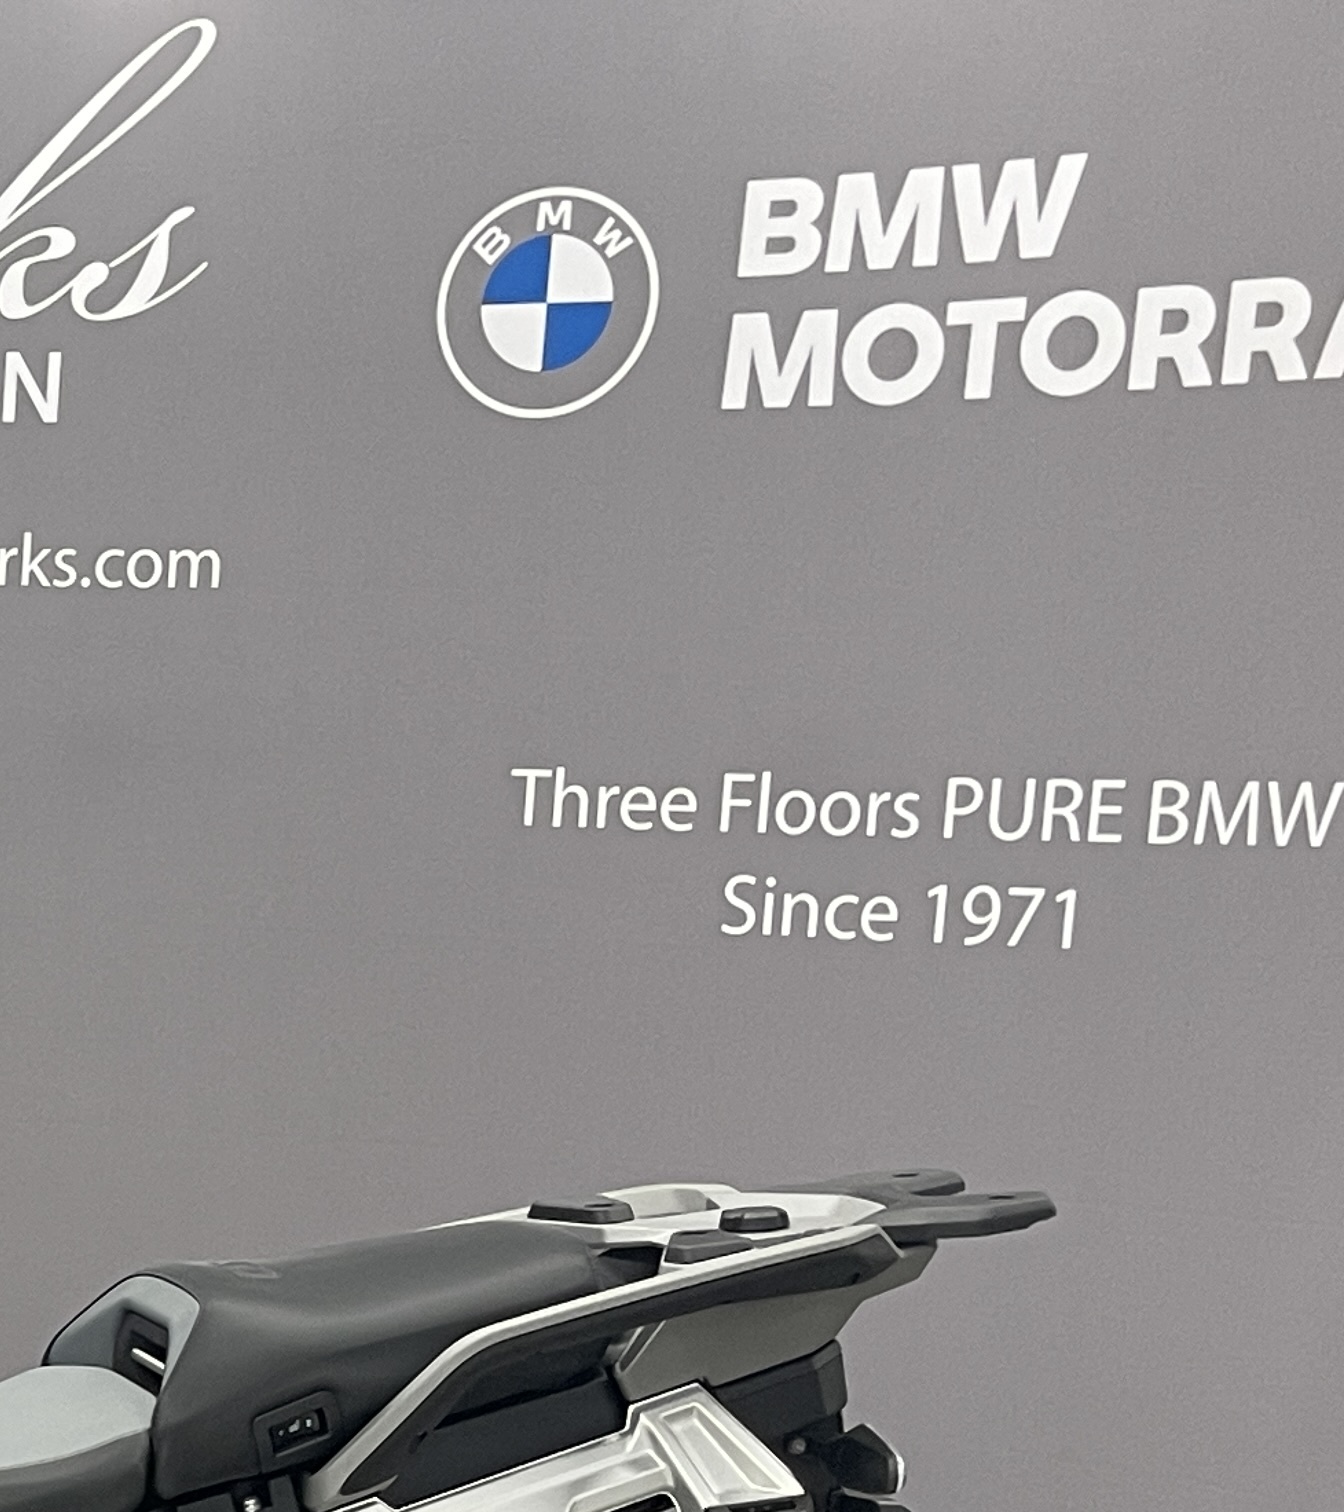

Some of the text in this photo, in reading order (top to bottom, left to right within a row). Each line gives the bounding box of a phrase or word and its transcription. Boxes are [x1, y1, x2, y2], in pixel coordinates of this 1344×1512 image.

[472, 199, 635, 266] BMW
[737, 152, 1089, 278] BMW
[509, 766, 1344, 848] Three Floors PURE BMW
[719, 873, 1080, 951] Since 1971
